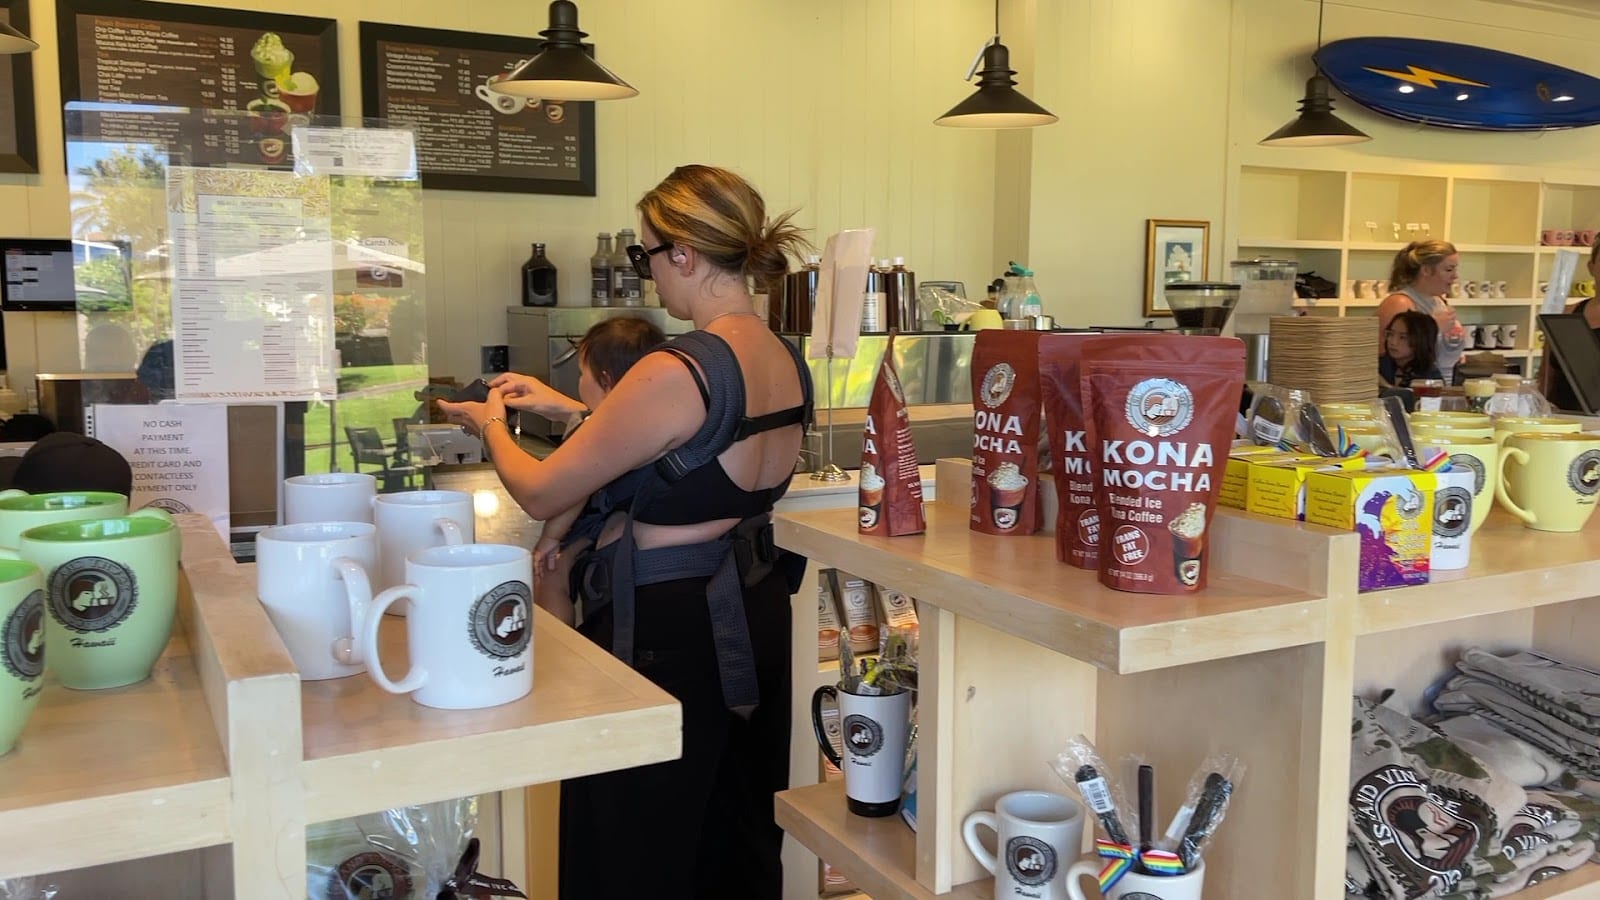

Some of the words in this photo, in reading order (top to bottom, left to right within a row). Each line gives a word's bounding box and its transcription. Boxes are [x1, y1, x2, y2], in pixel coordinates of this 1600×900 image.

[158, 420, 182, 428] CASH
[975, 410, 1024, 436] ONA
[1102, 440, 1214, 468] KONA
[134, 472, 194, 480] CONTACTLESS
[1103, 468, 1210, 492] MOCHA
[1070, 480, 1094, 492] Blend
[1070, 493, 1091, 504] Kona
[1144, 497, 1162, 508] Ice
[1080, 515, 1100, 528] TRAN
[1128, 510, 1163, 523] Coffee
[1116, 530, 1140, 544] TRANS
[1122, 541, 1136, 552] FAT
[1123, 549, 1144, 562] FREE
[70, 637, 117, 649] Hawaii
